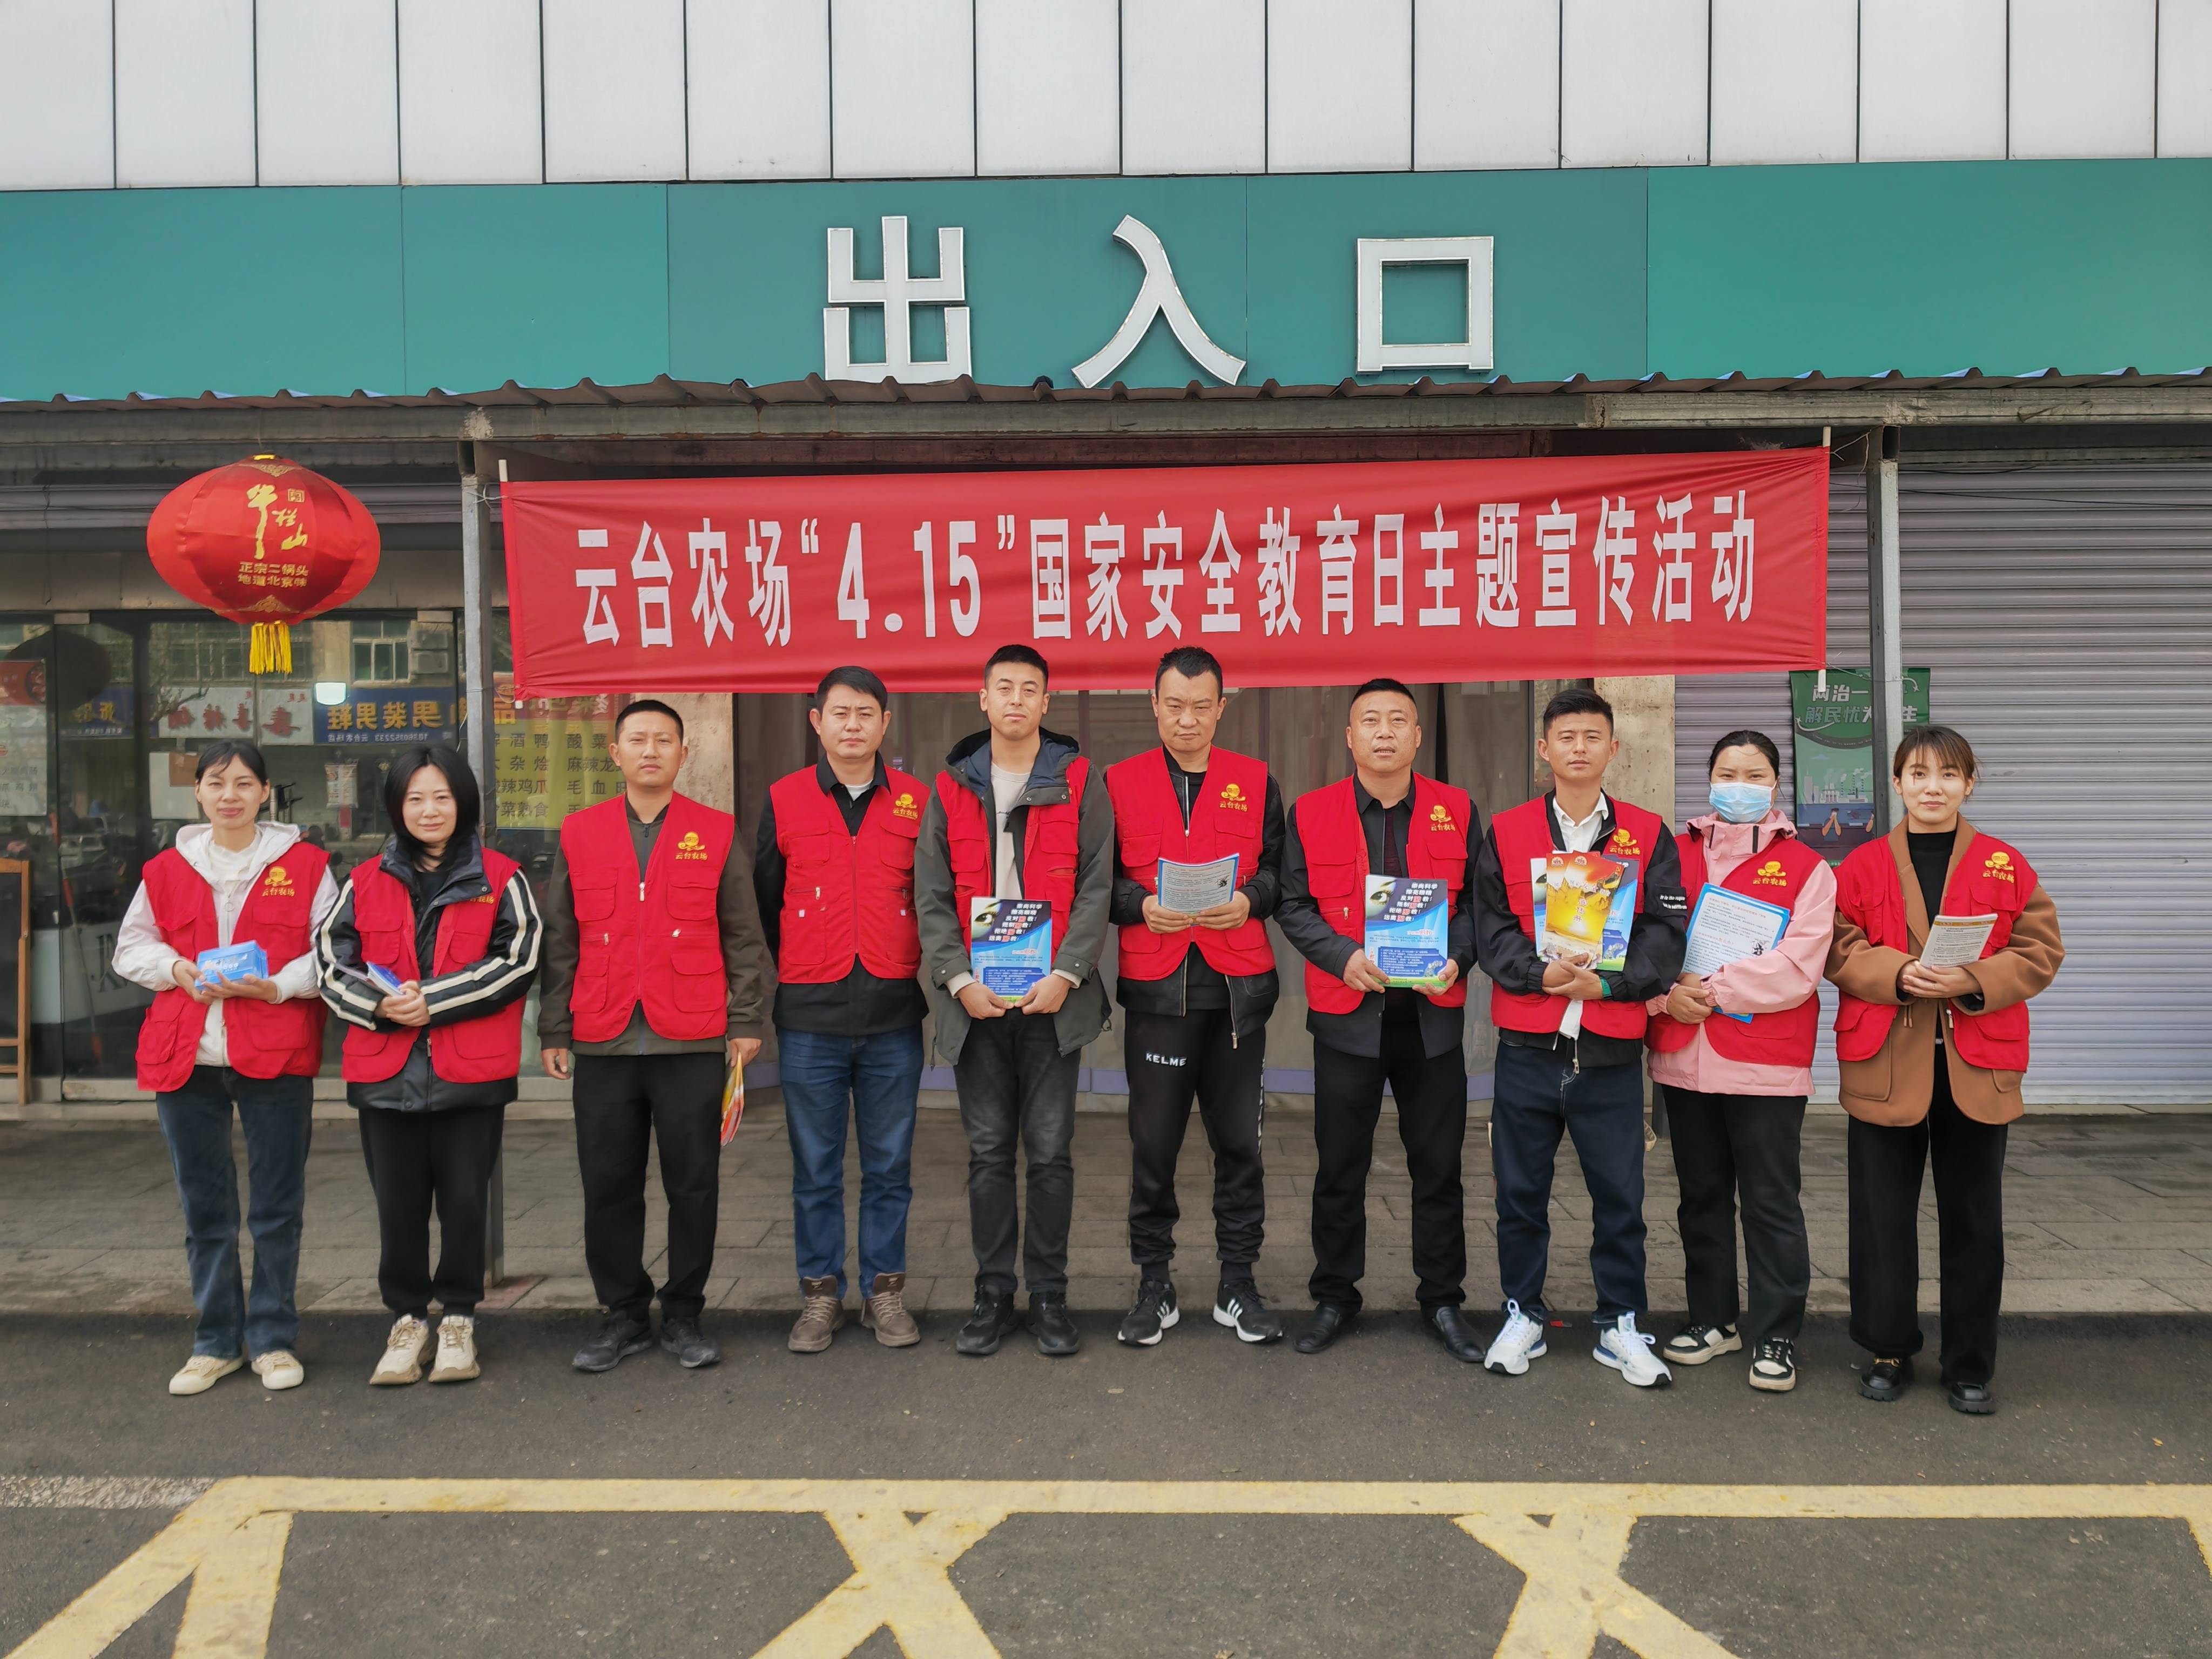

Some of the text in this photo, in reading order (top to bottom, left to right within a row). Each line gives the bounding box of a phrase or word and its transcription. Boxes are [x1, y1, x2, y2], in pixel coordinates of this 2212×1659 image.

[823, 214, 1495, 388] 出入口
[239, 561, 309, 576] 正宗二锅头
[238, 574, 307, 588] 地道北京味
[568, 757, 622, 772] 麻辣龙
[496, 801, 549, 818] 菜熟食
[1219, 801, 1247, 812] 云台农场
[893, 808, 918, 818] 云台农场
[1431, 824, 1456, 832] 云台农场
[676, 852, 708, 860] 云台农场
[1609, 845, 1640, 855] 云台农场
[1753, 878, 1786, 887] 云台农场
[1982, 869, 2014, 884] 云台农场
[262, 887, 295, 896] 云台农场
[1145, 1053, 1188, 1067] KELME
